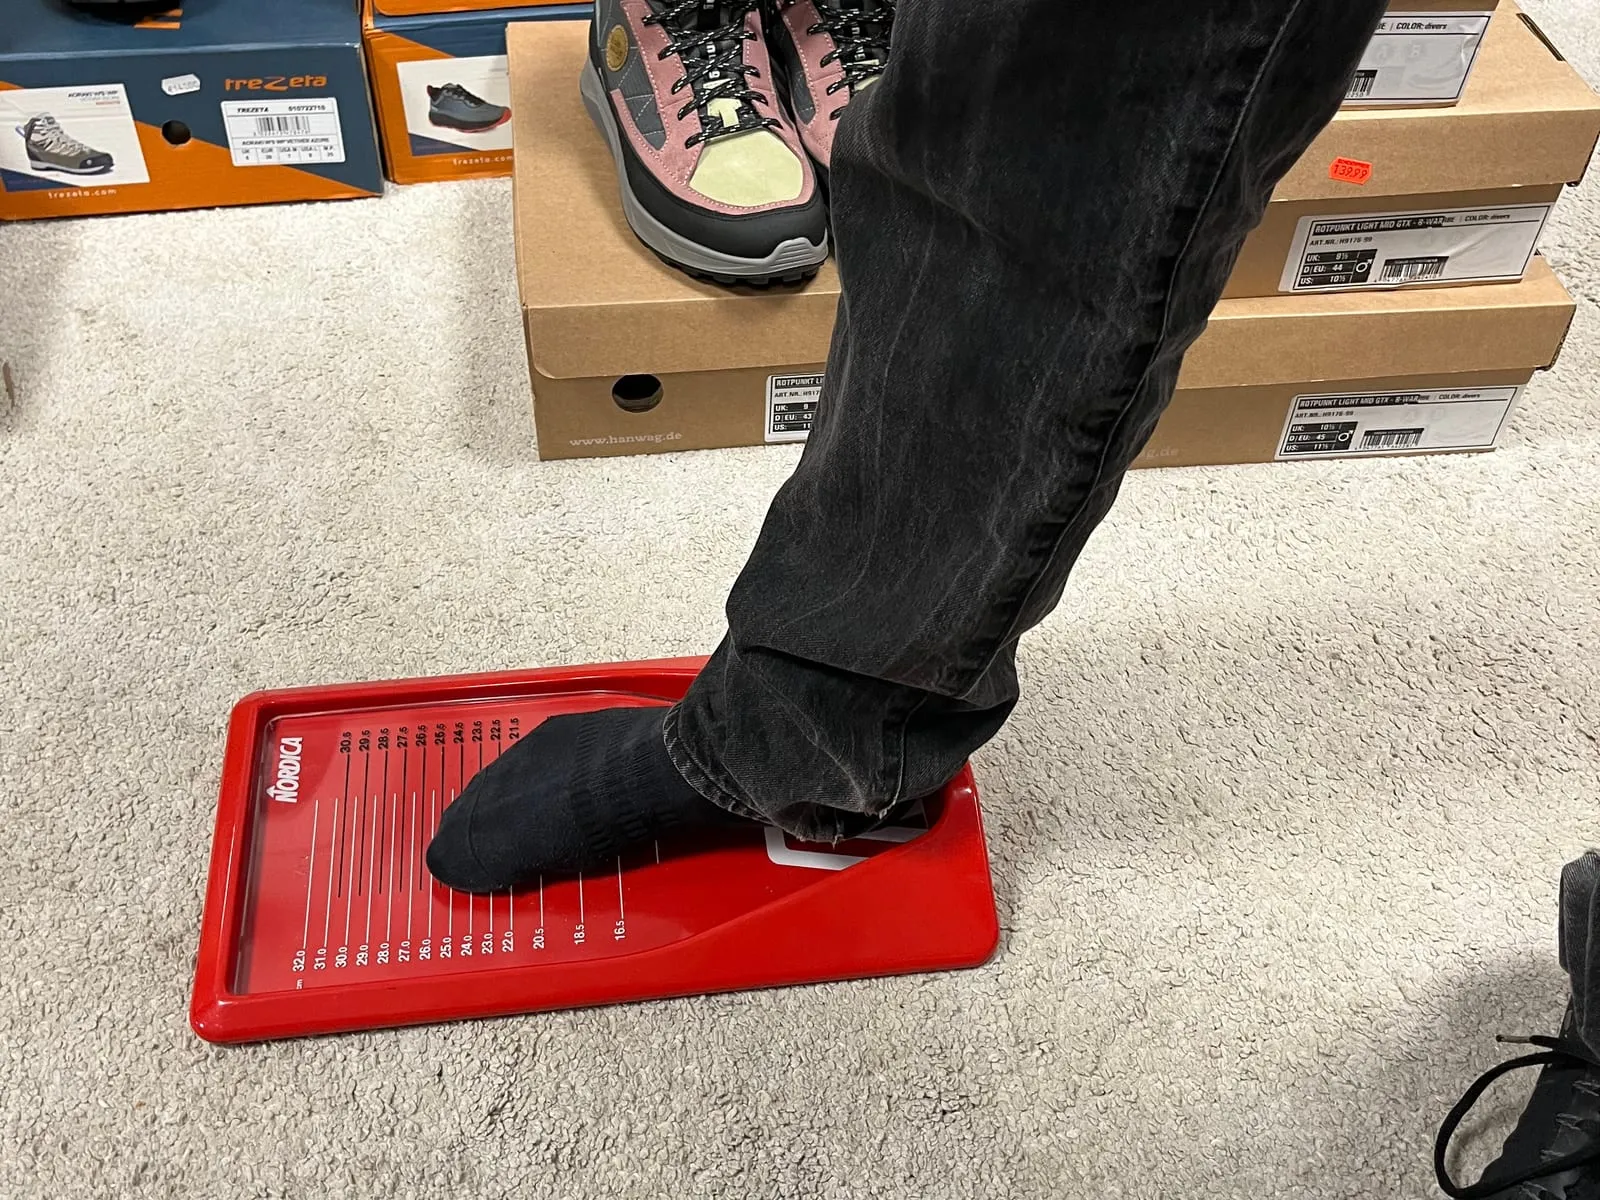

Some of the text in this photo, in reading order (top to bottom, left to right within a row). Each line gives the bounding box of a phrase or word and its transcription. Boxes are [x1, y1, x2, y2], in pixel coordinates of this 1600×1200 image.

[48, 188, 117, 200] trezeta.com
[1315, 222, 1355, 234] ROTPUNKT
[1356, 221, 1378, 232] LIGHT
[1396, 219, 1411, 228] GTX
[1306, 254, 1321, 262] UK:
[1300, 277, 1314, 285] US:
[776, 378, 815, 387] ROTPUNKT
[1300, 398, 1337, 408] ROTPUNKT
[1338, 397, 1360, 406] LIGHT
[1375, 396, 1389, 404] GTX
[569, 431, 683, 447] www.hanwag.de
[1286, 444, 1298, 452] US:
[378, 727, 389, 750] 28.5
[397, 726, 408, 748] 27.5
[416, 724, 427, 747] 26.5
[435, 723, 446, 745] 25.5
[453, 722, 464, 744] 24.5
[472, 720, 482, 742] 23.5
[490, 719, 501, 741] 22.5
[509, 718, 520, 740] 21.5
[340, 731, 352, 753] 30.5
[359, 729, 371, 752] 29.5
[267, 736, 303, 803] NORDICA
[502, 931, 514, 952] 22.0
[533, 927, 545, 949] 20.5
[573, 924, 586, 945] 18.5
[613, 920, 626, 941] 16.5
[376, 942, 390, 964] 28.0
[398, 940, 411, 962] 27.0
[419, 938, 432, 960] 26.0
[440, 937, 452, 958] 25.0
[461, 935, 473, 956] 24.0
[481, 933, 494, 954] 23.0
[292, 950, 306, 972] 32.0
[313, 948, 327, 970] 31.0
[334, 946, 348, 968] 30.0
[355, 944, 369, 966] 29.0
